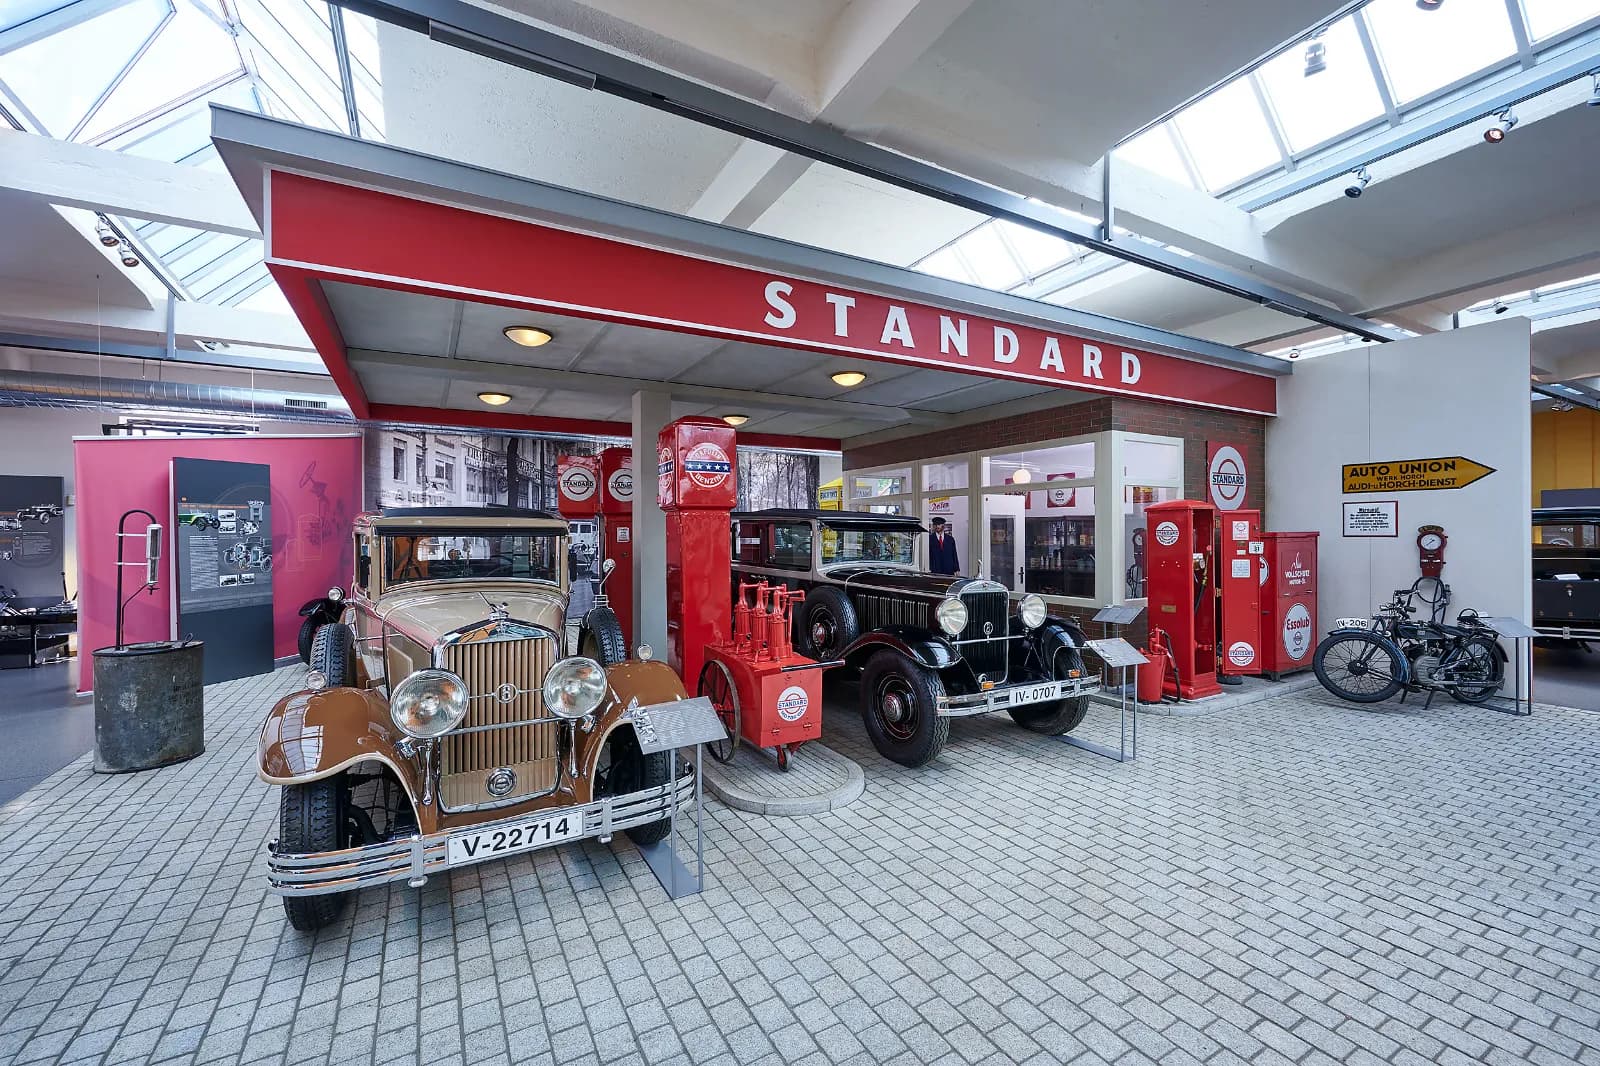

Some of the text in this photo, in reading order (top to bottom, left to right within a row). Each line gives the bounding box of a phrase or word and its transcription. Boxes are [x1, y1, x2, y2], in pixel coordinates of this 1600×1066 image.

[763, 280, 1141, 385] STANDARD
[1349, 460, 1456, 478] AUTO UNION
[563, 480, 594, 488] STANDARD
[694, 473, 723, 485] BENZIN
[1212, 474, 1245, 485] STANDARD
[1286, 616, 1310, 630] Essolub
[778, 699, 808, 709] STANDARD
[461, 817, 570, 857] V-22714
